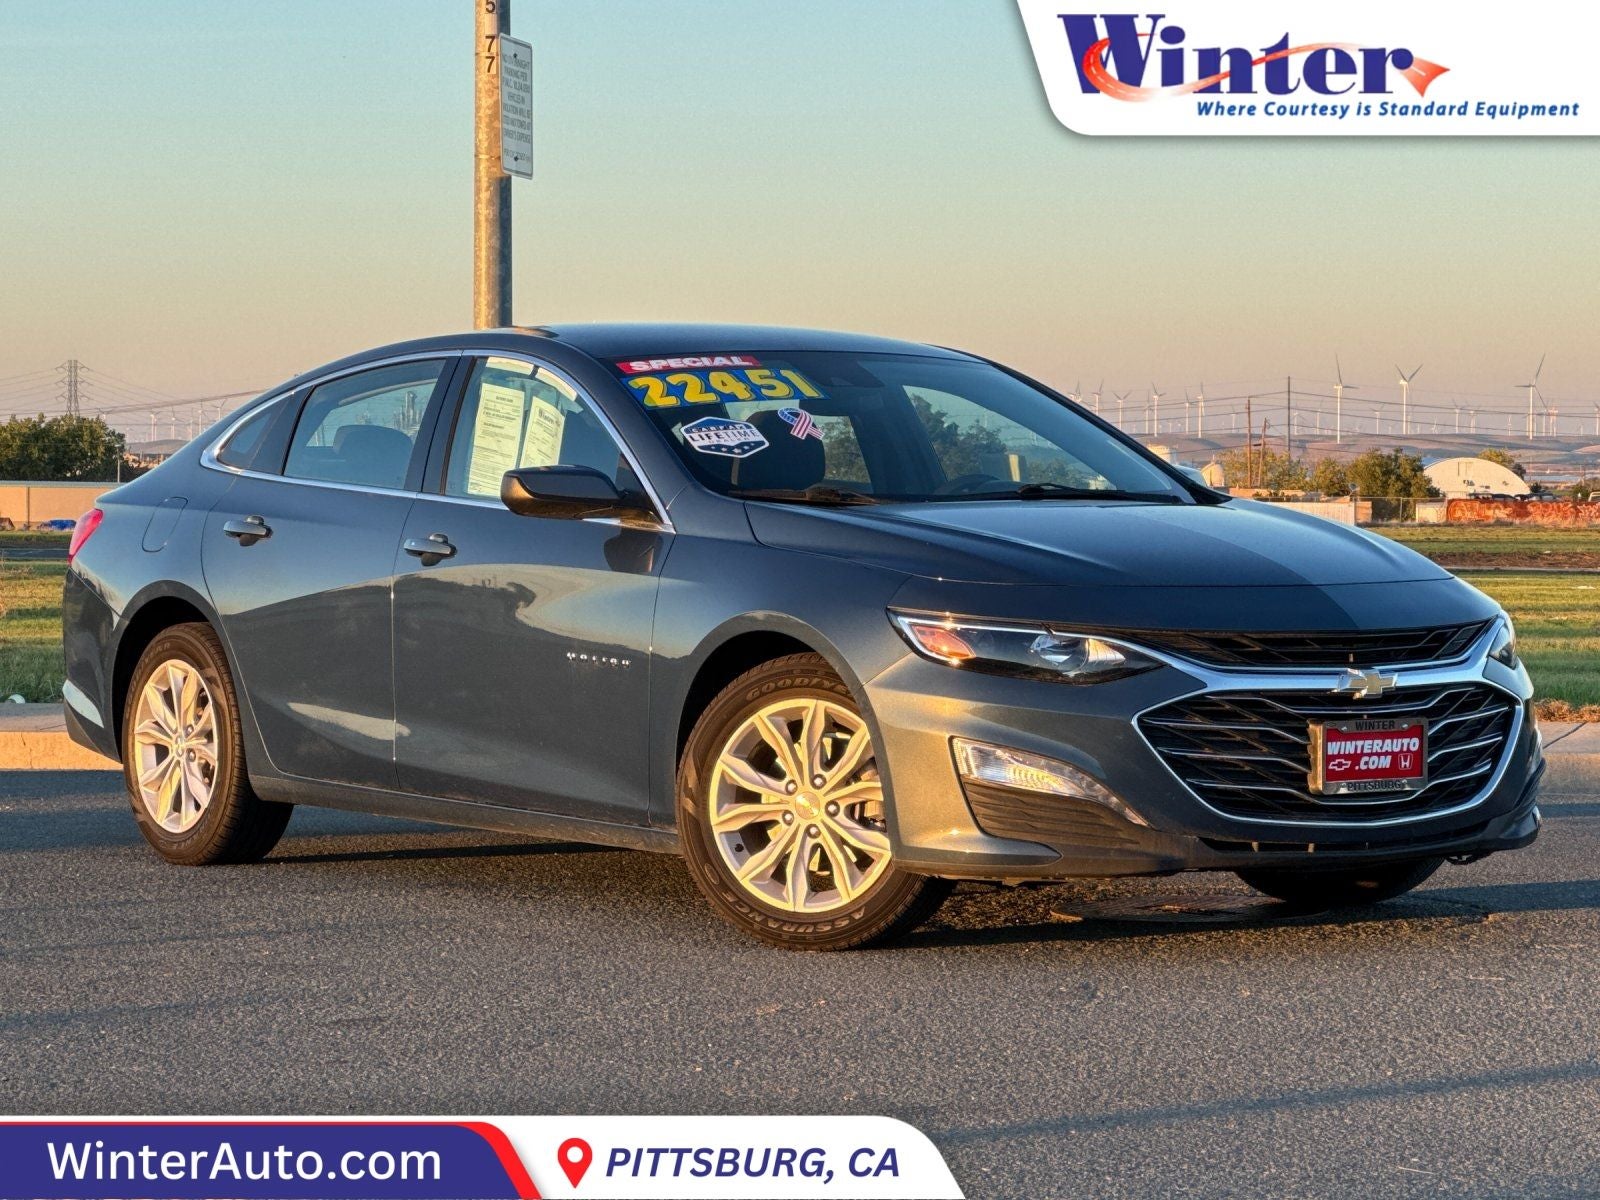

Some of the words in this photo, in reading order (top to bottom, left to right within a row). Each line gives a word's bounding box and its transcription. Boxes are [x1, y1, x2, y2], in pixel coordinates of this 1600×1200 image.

[629, 355, 753, 373] SPECIAL
[627, 368, 823, 407] 22451
[688, 429, 760, 442] LIFETIME
[1355, 719, 1395, 731] WINTER
[1327, 737, 1419, 755] WINTERAUTO
[1355, 755, 1392, 770] .COM
[1347, 780, 1401, 792] PITTSBURG
